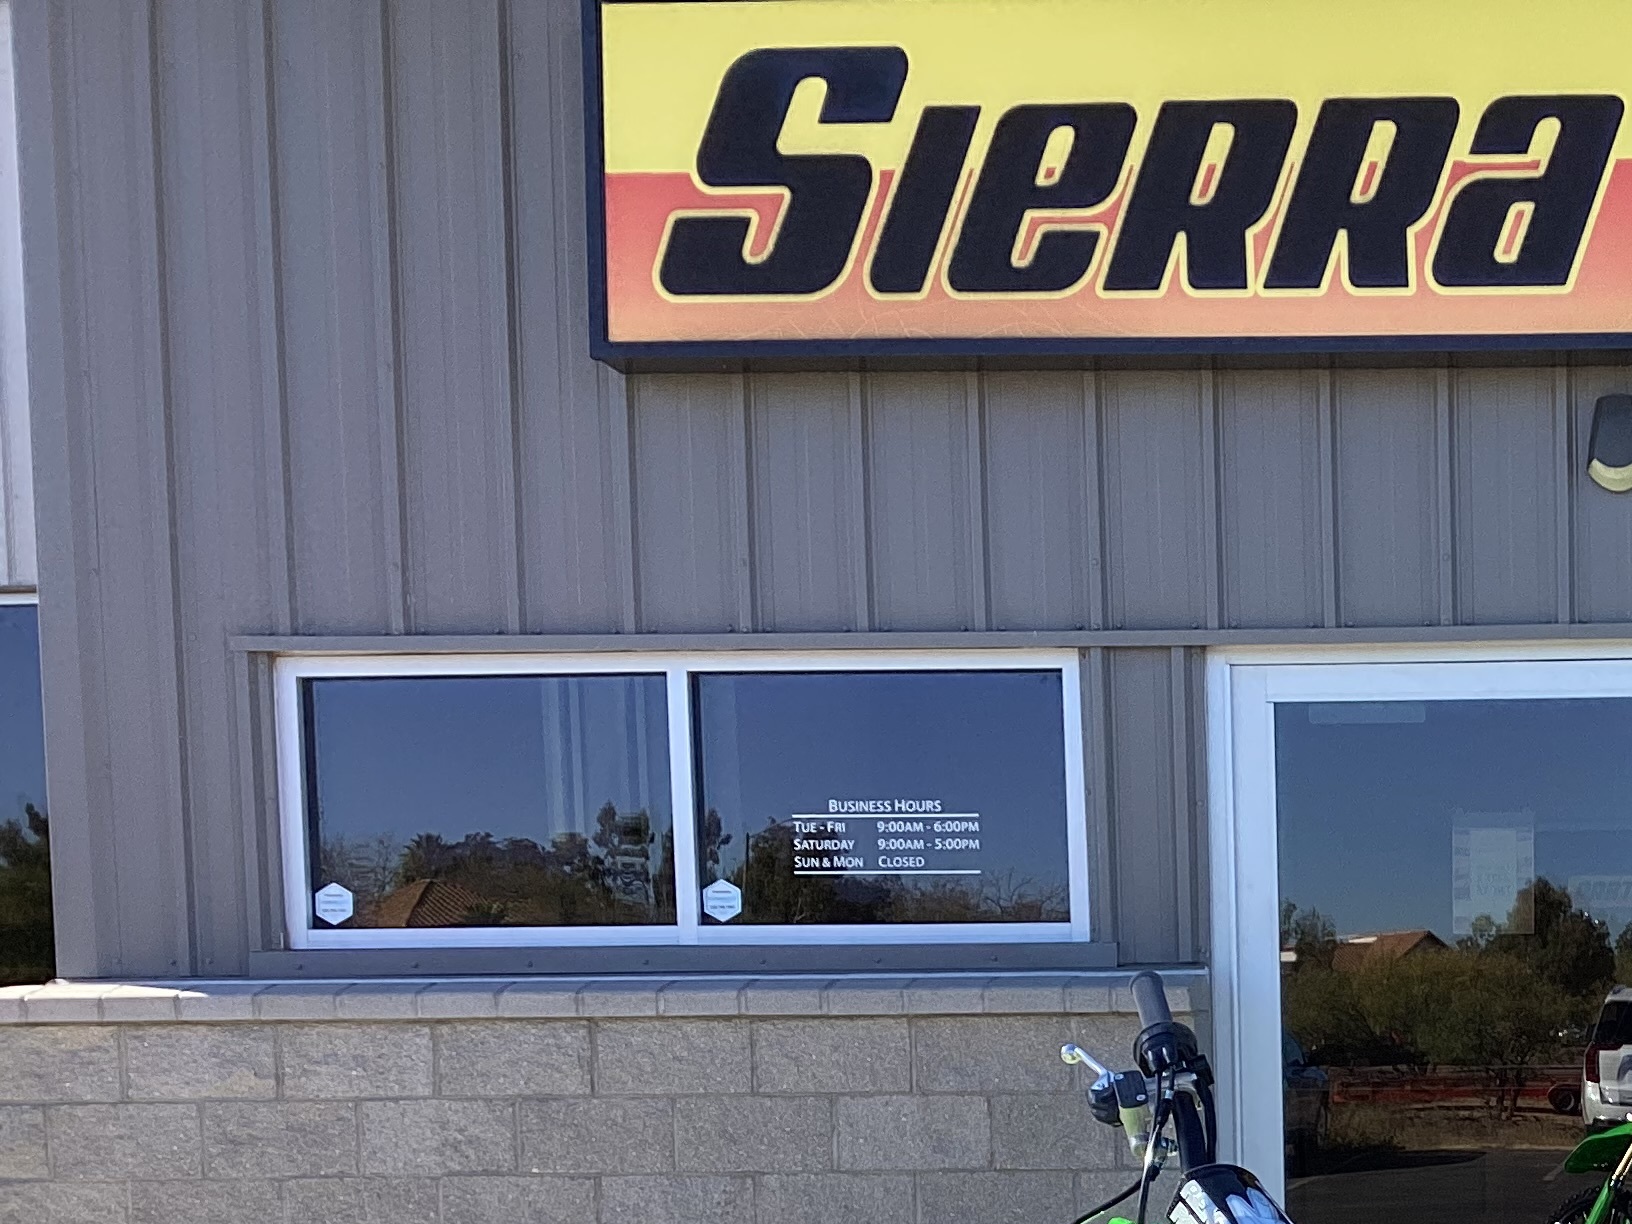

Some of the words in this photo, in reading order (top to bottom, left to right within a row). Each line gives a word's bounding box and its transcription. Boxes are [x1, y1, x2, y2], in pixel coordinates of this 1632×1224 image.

[876, 821, 924, 833] 9:00AM
[933, 821, 979, 832] 6:00PM
[877, 839, 924, 850] 9:00AM
[934, 839, 980, 850] 5:00PM
[821, 857, 831, 868] &
